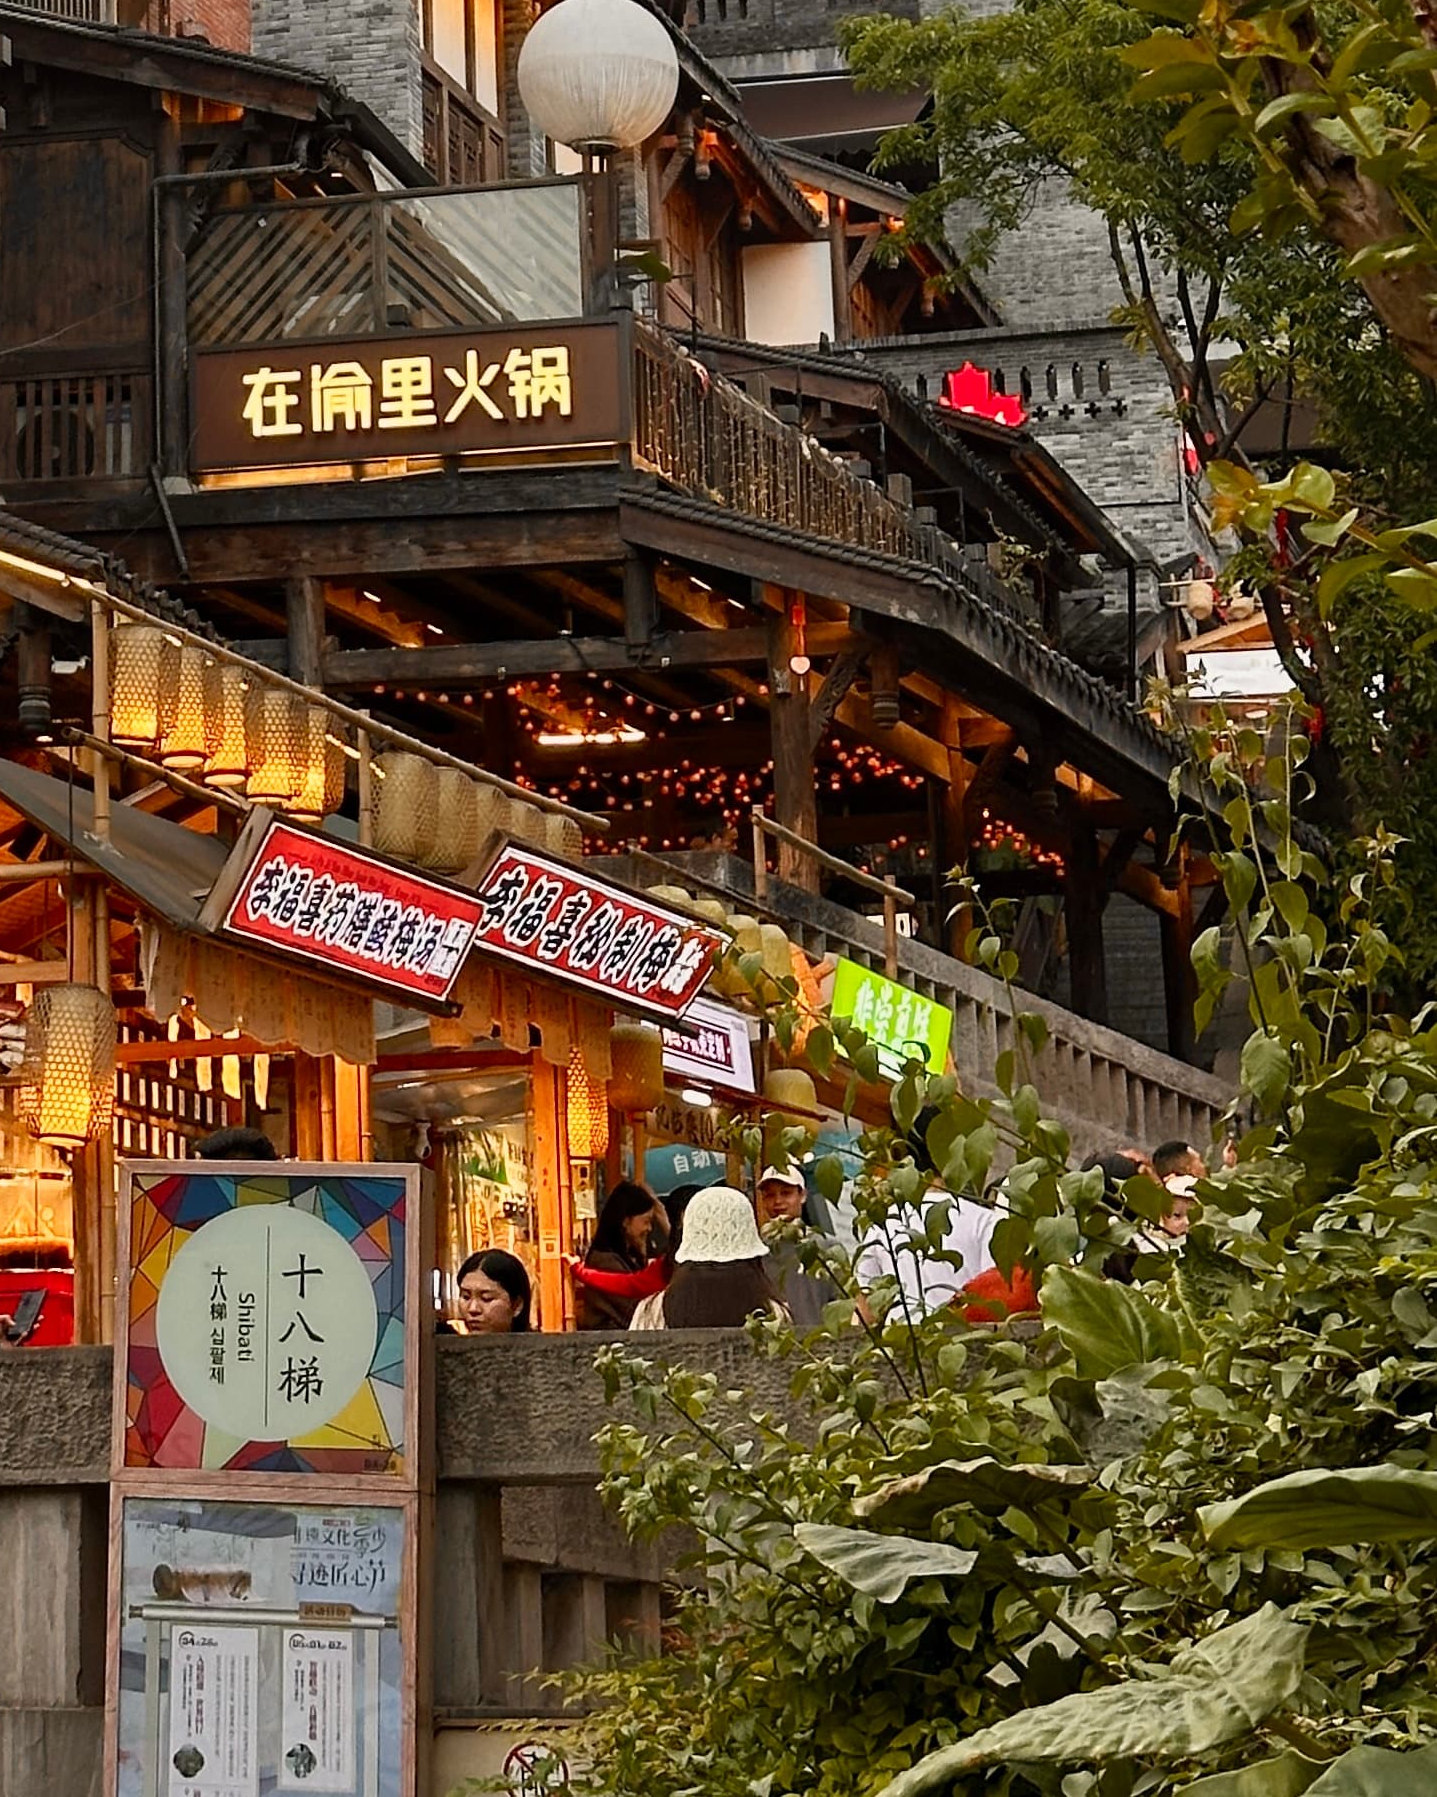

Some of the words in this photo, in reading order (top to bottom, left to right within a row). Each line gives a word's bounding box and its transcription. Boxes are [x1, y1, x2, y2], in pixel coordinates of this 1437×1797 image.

[236, 1291, 257, 1363] Shibati
[276, 1252, 326, 1405] 十八梯
